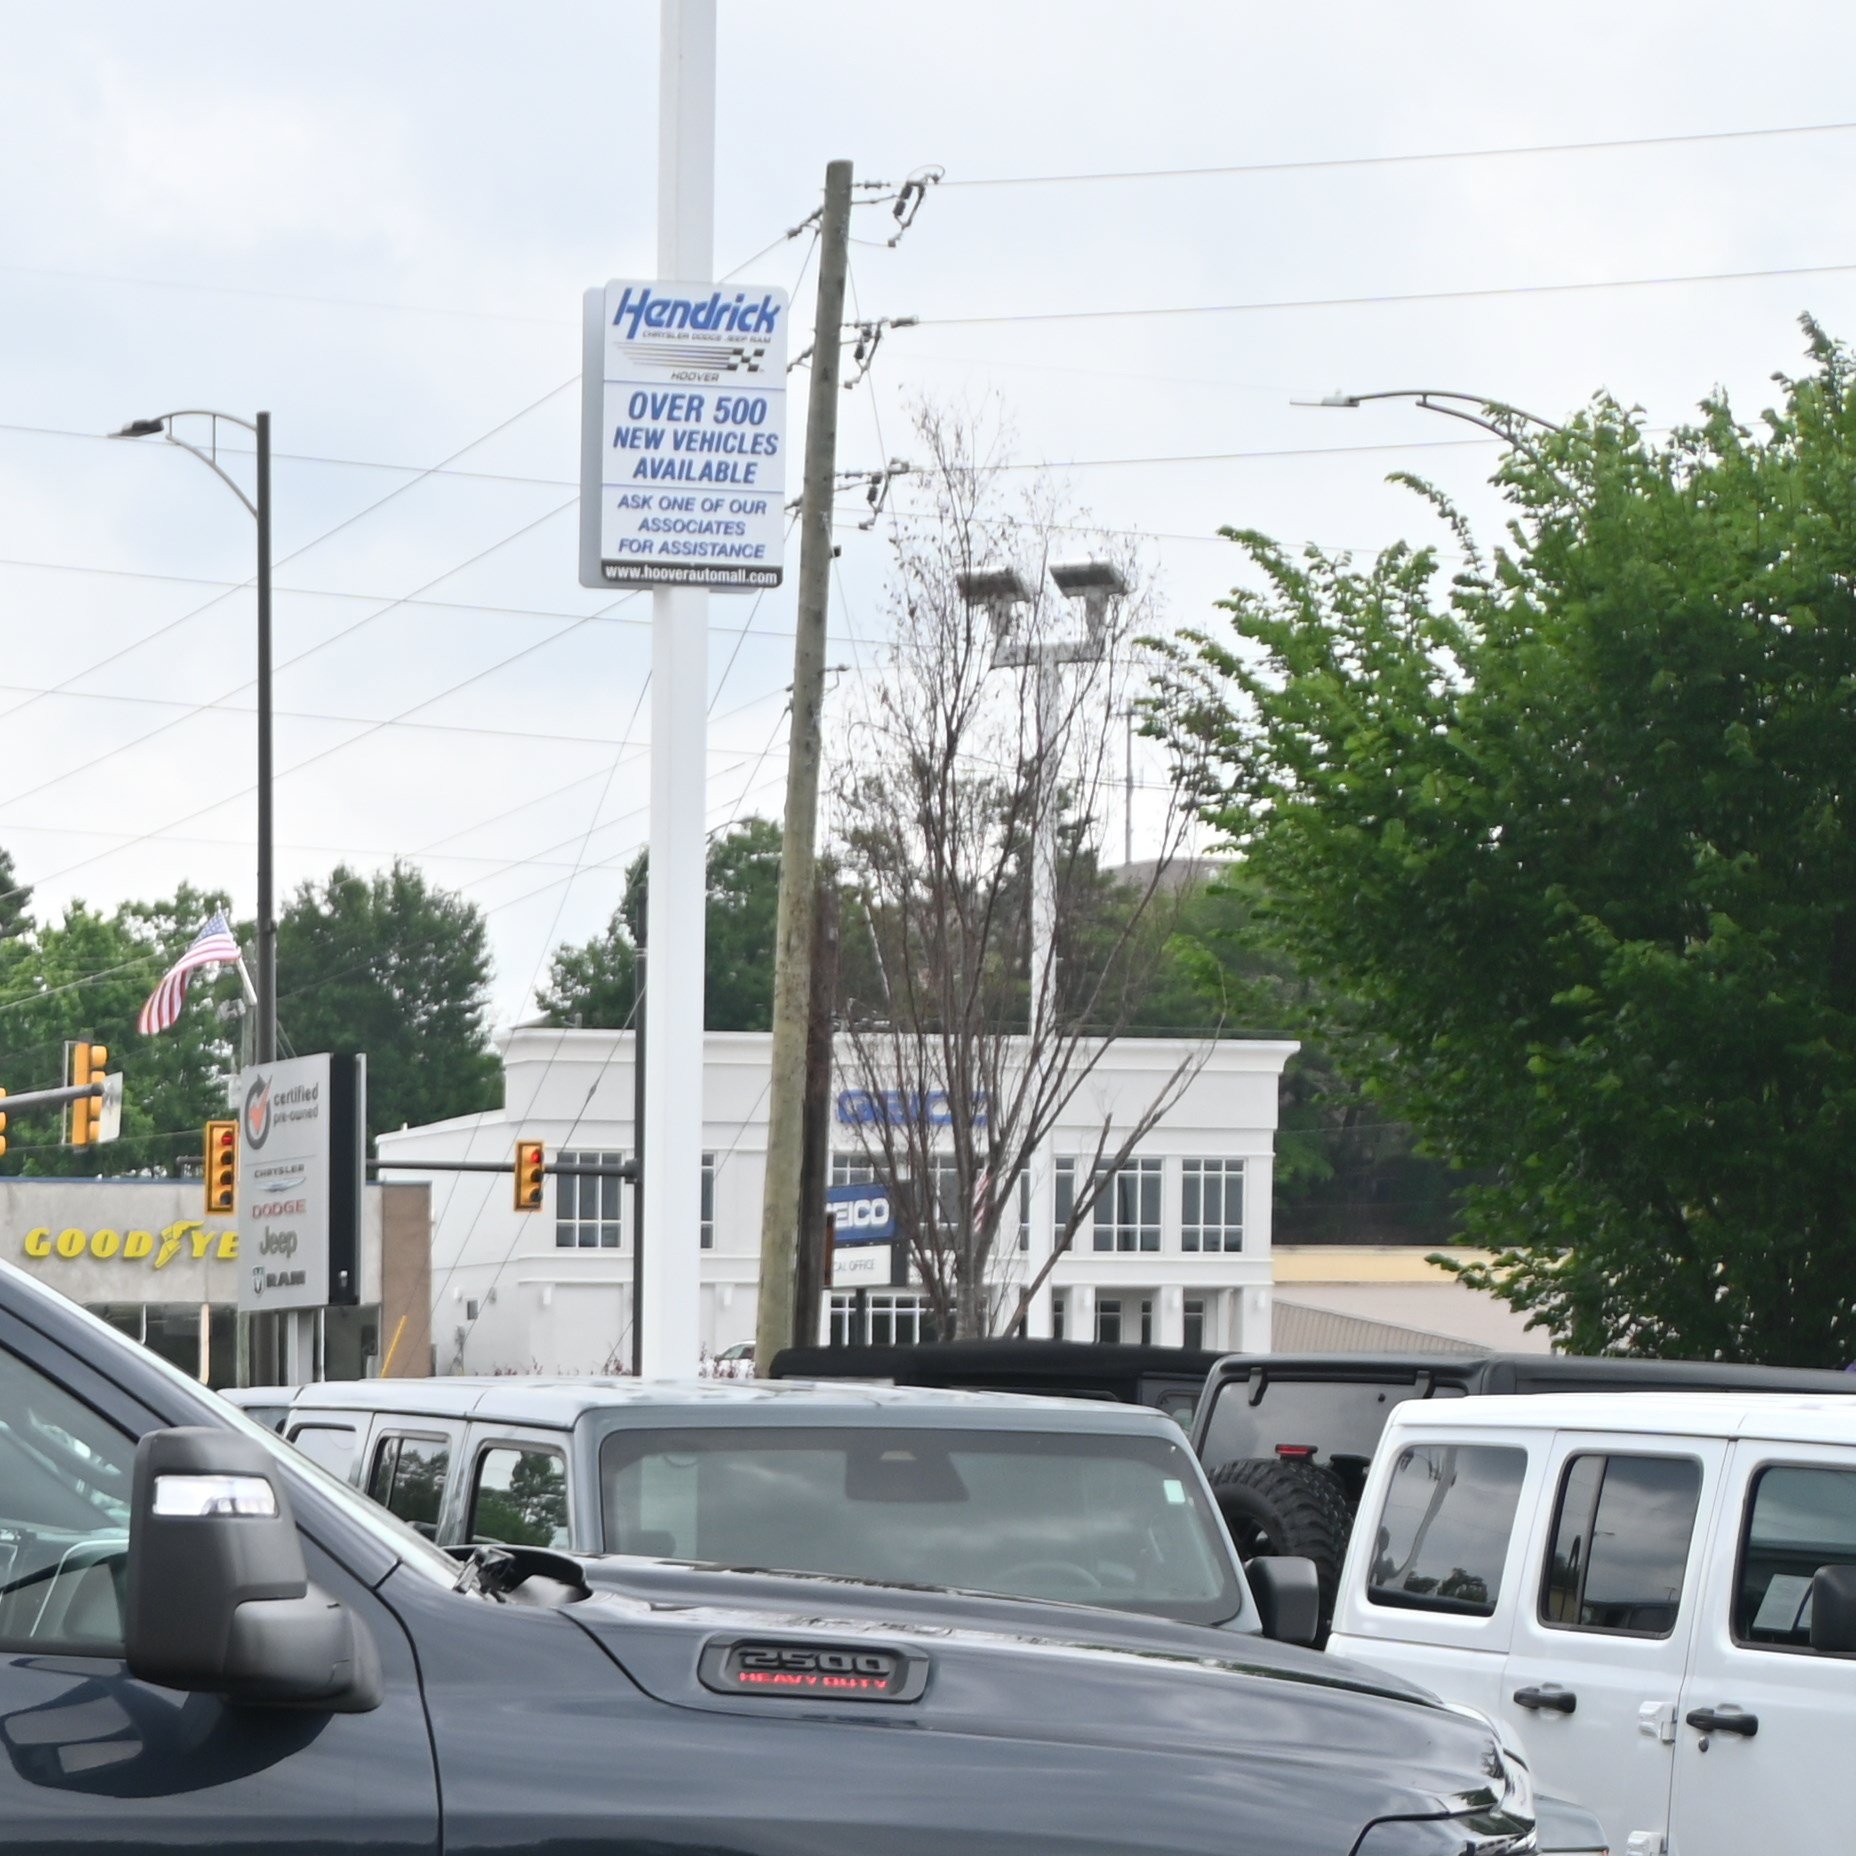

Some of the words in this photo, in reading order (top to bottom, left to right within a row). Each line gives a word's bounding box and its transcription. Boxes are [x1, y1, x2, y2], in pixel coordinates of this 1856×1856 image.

[612, 287, 781, 340] Hendrick
[671, 371, 720, 382] HOOVER
[628, 391, 705, 422] OVER
[713, 395, 768, 425] 500
[613, 426, 665, 450] NEW
[673, 428, 779, 455] VEHICLES
[632, 457, 758, 484] AVAILABLE
[618, 494, 653, 509] ASK
[658, 496, 696, 511] ONE
[701, 497, 725, 513] OF
[729, 499, 767, 514] OUR
[638, 517, 746, 536] ASSOCIATES
[618, 538, 654, 554] FOR
[658, 540, 766, 559] ASSISTANCE
[605, 564, 778, 584] www.hooverautomall.com
[273, 1081, 319, 1106] certified
[273, 1106, 319, 1128] pre-owned
[254, 1164, 304, 1178] CHRYSLER
[252, 1199, 306, 1219] DODGE
[826, 1198, 890, 1228] EICO
[259, 1225, 298, 1258] Jeep
[848, 1259, 875, 1271] OFFICE
[266, 1269, 306, 1288] RAM
[740, 1650, 890, 1676] 2500
[739, 1672, 817, 1686] HEAVY
[823, 1677, 888, 1690] DUTY
